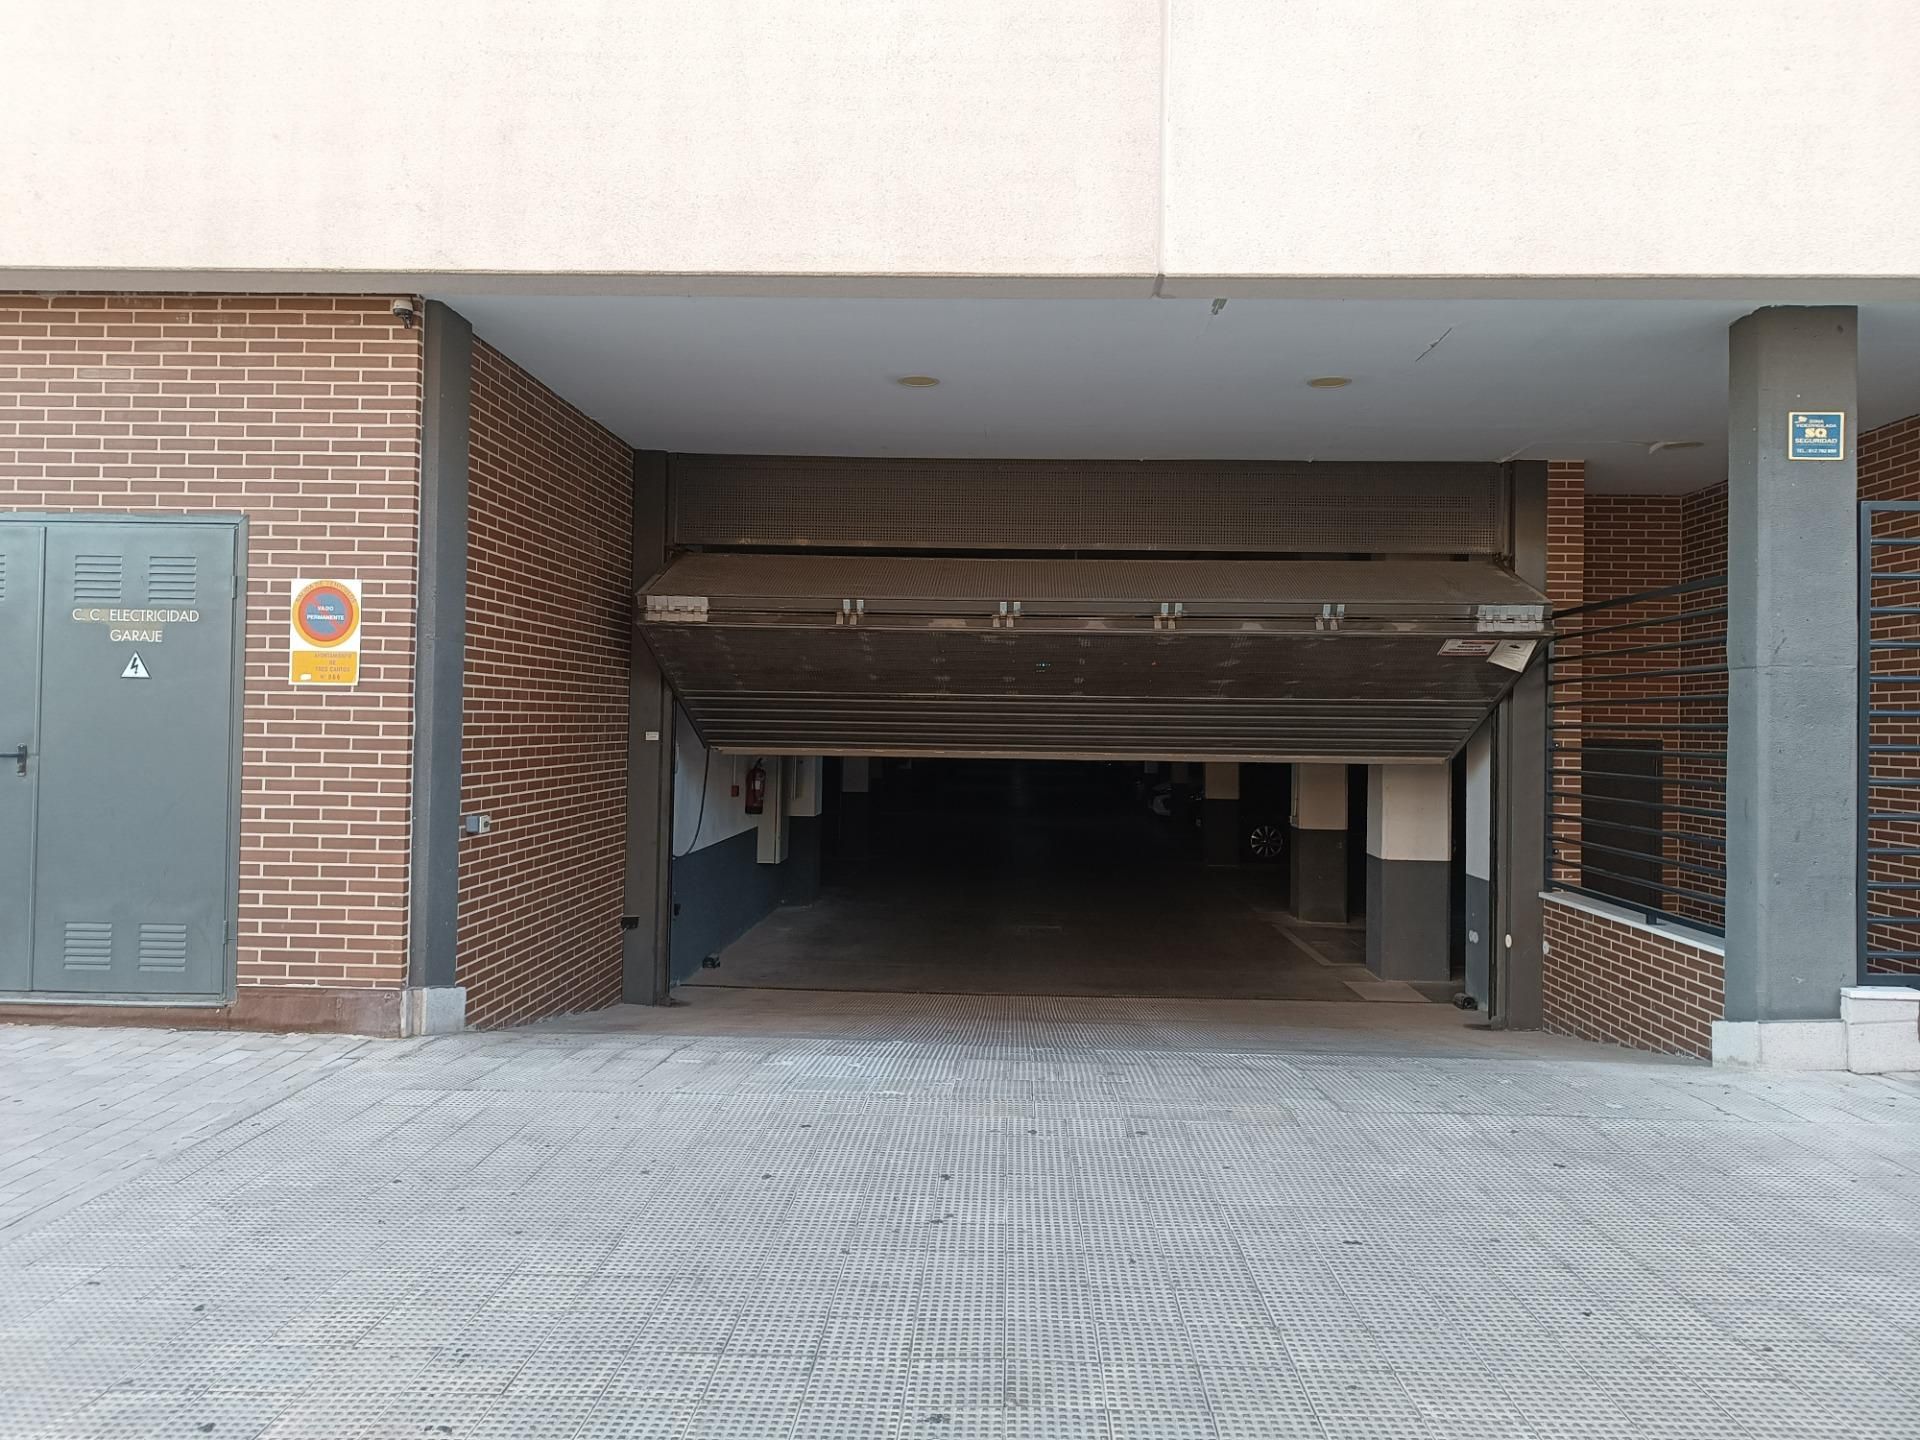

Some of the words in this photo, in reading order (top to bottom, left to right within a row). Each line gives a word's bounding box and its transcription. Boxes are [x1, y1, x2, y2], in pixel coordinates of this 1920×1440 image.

[1805, 427, 1827, 438] SQ
[109, 608, 200, 622] ELECTRICIDAD
[306, 613, 345, 621] PERMANENTE
[110, 629, 163, 643] GARAJE
